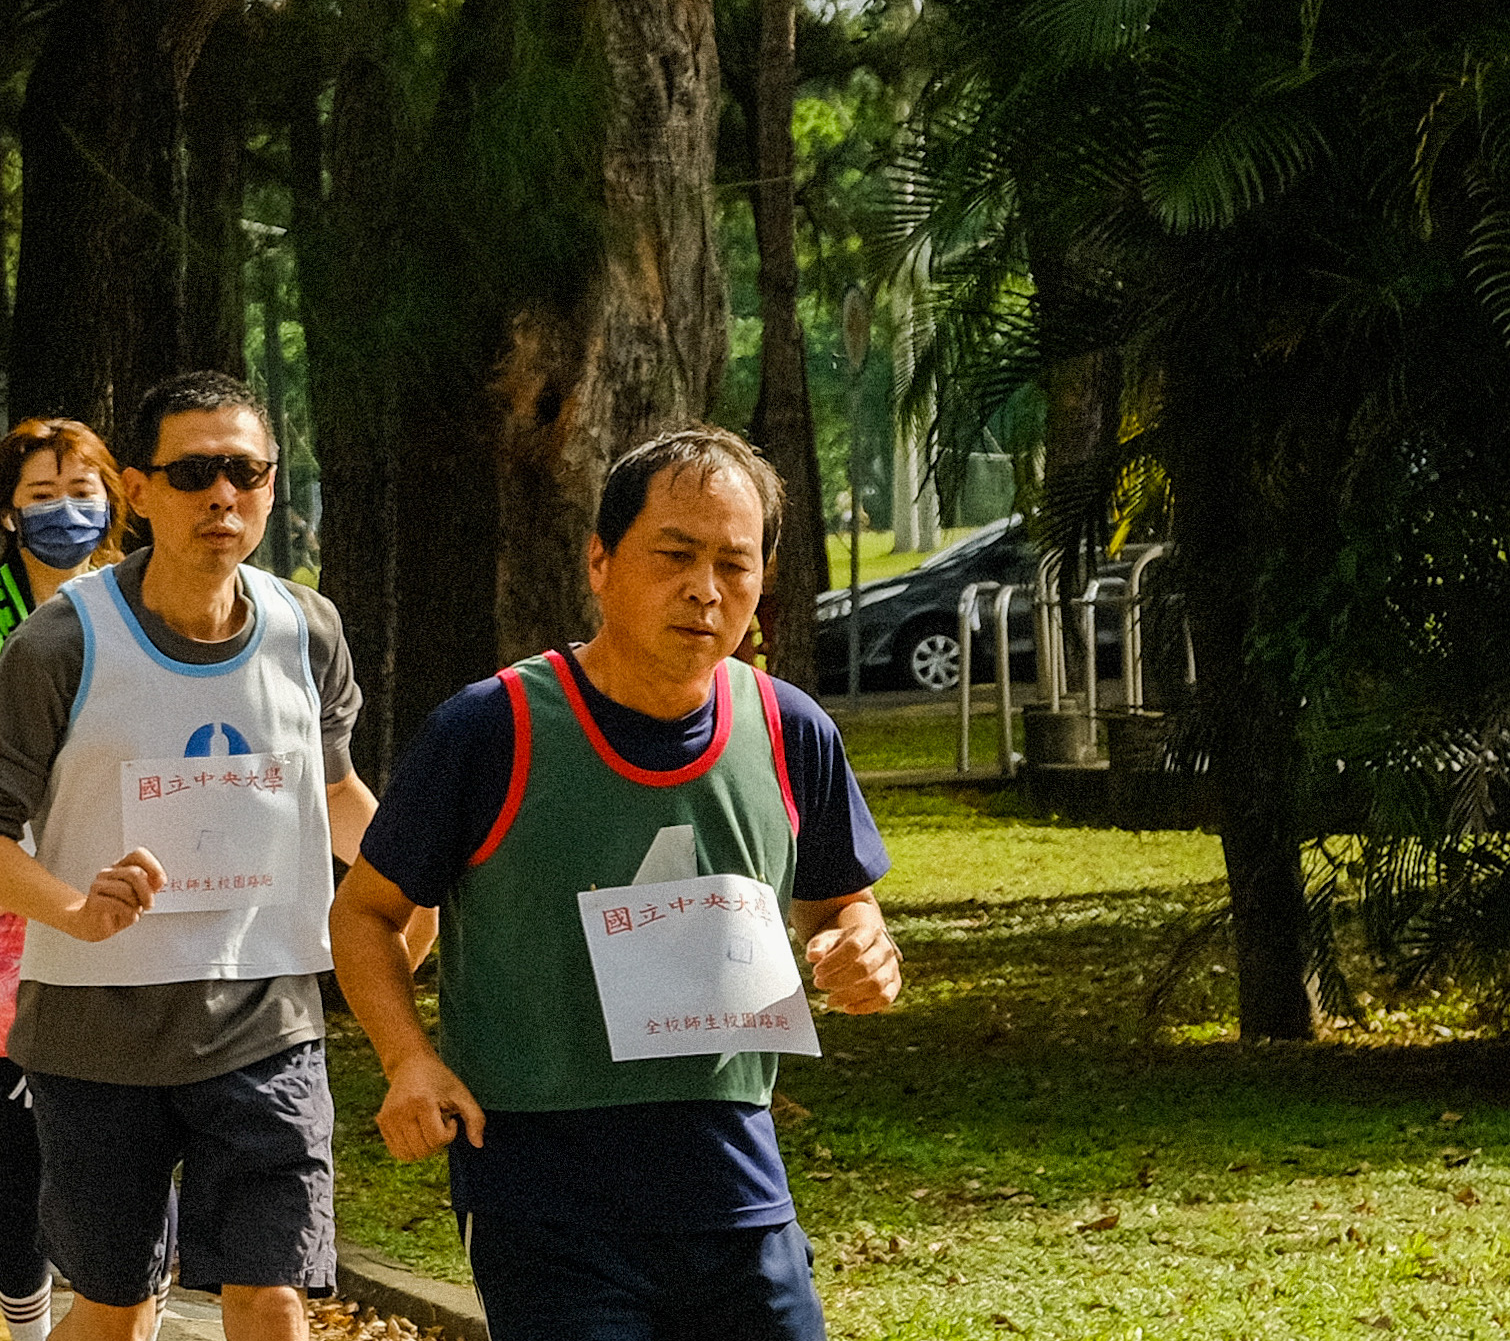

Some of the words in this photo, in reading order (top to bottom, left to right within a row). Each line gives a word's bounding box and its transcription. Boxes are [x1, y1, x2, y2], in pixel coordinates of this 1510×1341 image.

[139, 766, 284, 801] 國立中央大學
[602, 893, 773, 936] 國立中央大學
[646, 1013, 791, 1036] 全校師生校園路跑
